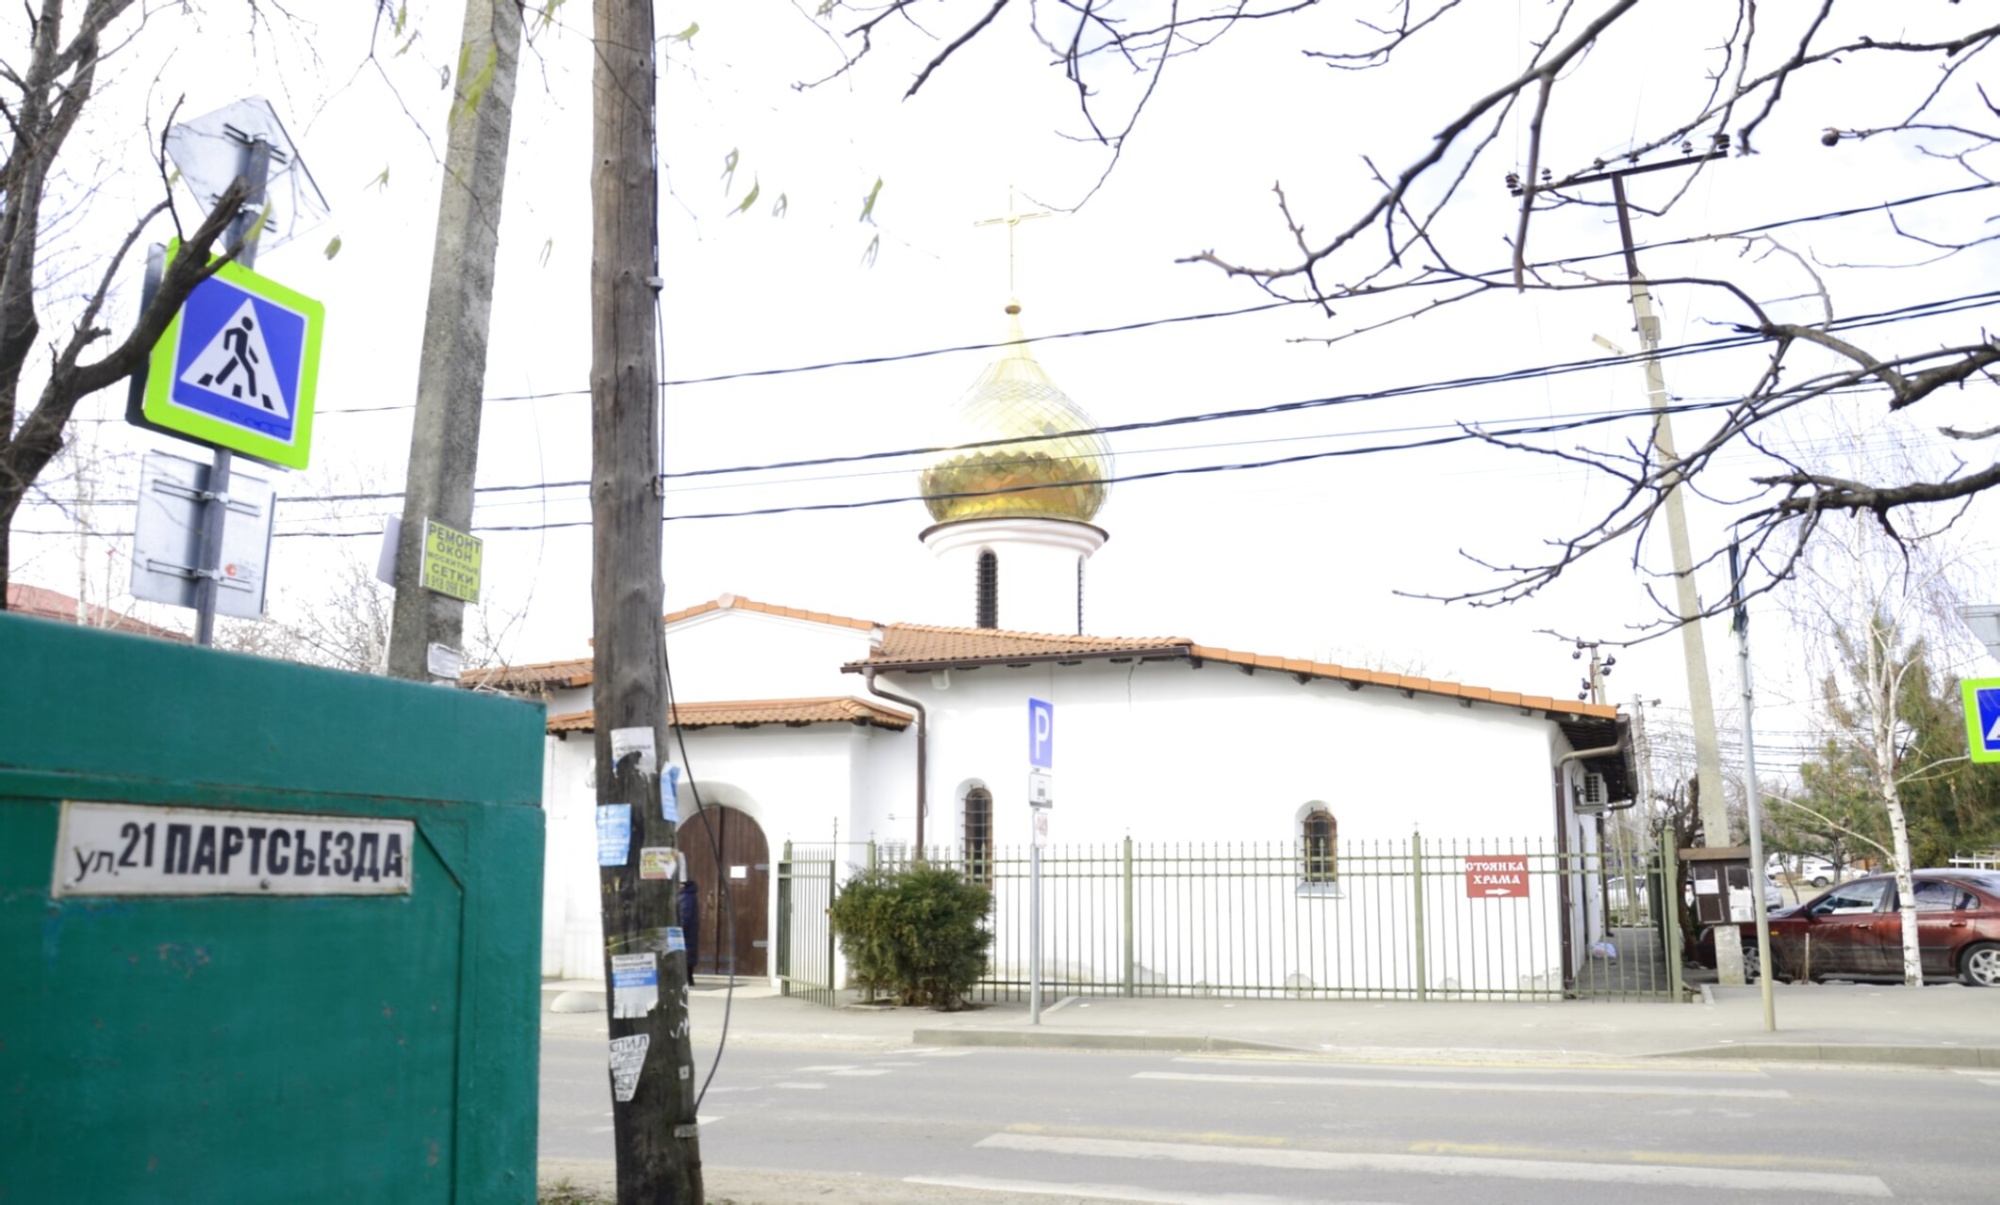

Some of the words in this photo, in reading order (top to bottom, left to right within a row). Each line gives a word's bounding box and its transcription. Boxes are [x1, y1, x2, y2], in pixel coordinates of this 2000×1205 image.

[428, 524, 481, 554] РЕМОНТ
[436, 541, 472, 563] ОКОН
[431, 563, 474, 586] СЕТКИ
[74, 844, 119, 881] ул.
[163, 823, 401, 882] ПАРТСЪЕЗДА
[1473, 875, 1521, 884] ХРАМА
